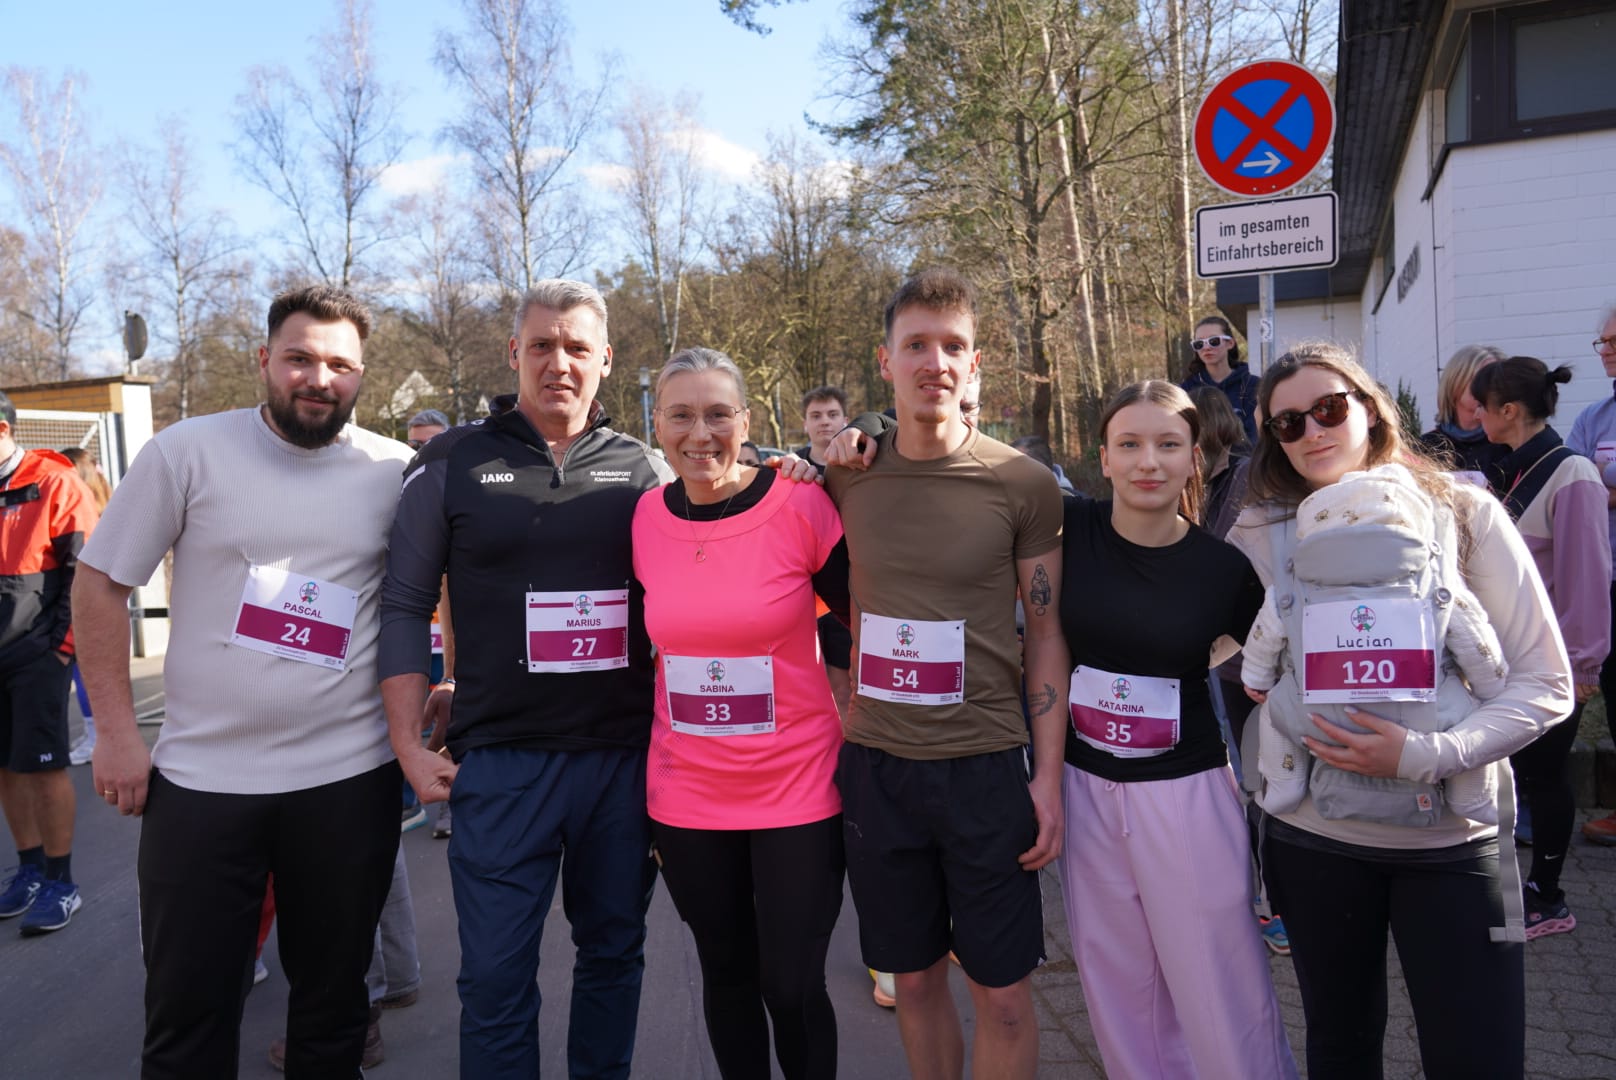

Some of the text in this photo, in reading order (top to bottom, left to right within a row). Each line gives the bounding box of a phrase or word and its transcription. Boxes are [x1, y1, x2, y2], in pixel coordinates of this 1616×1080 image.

[1219, 215, 1310, 239] im gesamten
[1207, 235, 1324, 263] Einfahrtsbereich
[480, 472, 515, 484] JAKO
[283, 602, 323, 619] PASCAL
[566, 618, 602, 627] MARIUS
[280, 622, 311, 646] 24
[1336, 635, 1393, 648] Lucian
[571, 637, 597, 657] 27
[892, 648, 920, 659] MARK
[892, 667, 919, 689] 54
[1342, 659, 1396, 684] 120
[700, 684, 735, 693] SABINA
[705, 703, 731, 722] 33
[1098, 699, 1145, 714] KATARINA
[1104, 721, 1132, 743] 35
